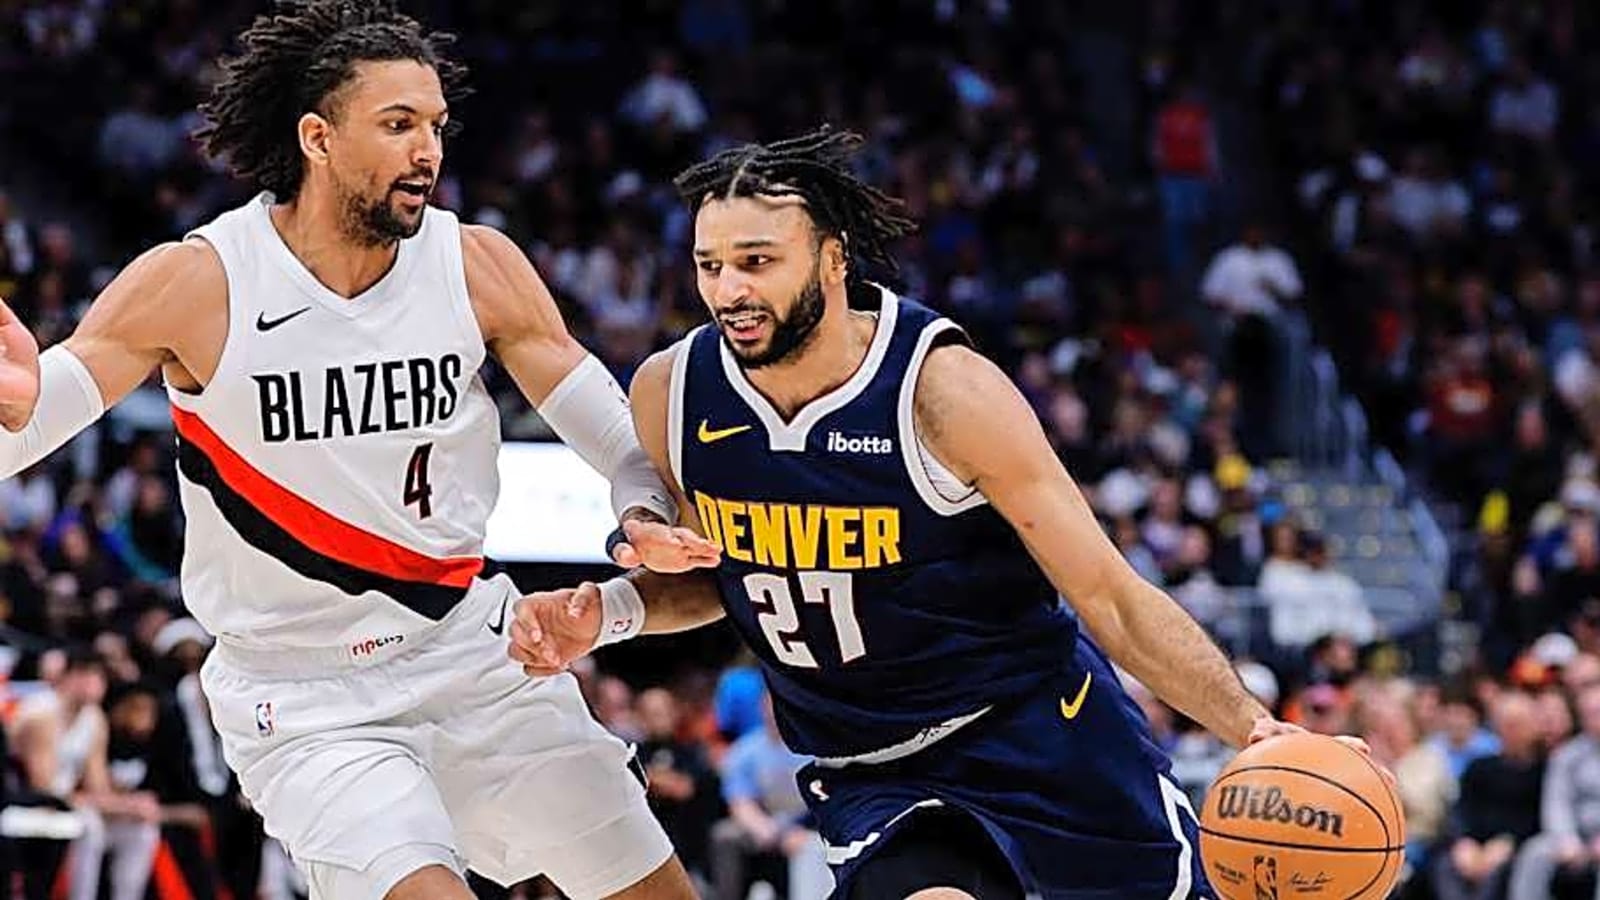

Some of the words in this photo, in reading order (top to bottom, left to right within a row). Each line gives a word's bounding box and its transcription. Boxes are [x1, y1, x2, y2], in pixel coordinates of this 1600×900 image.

[252, 353, 462, 443] BLAZERS
[402, 441, 434, 520] 4
[827, 431, 893, 454] ibotta
[694, 490, 902, 570] DENVER
[742, 570, 867, 668] 27
[1216, 785, 1345, 839] Wilson
